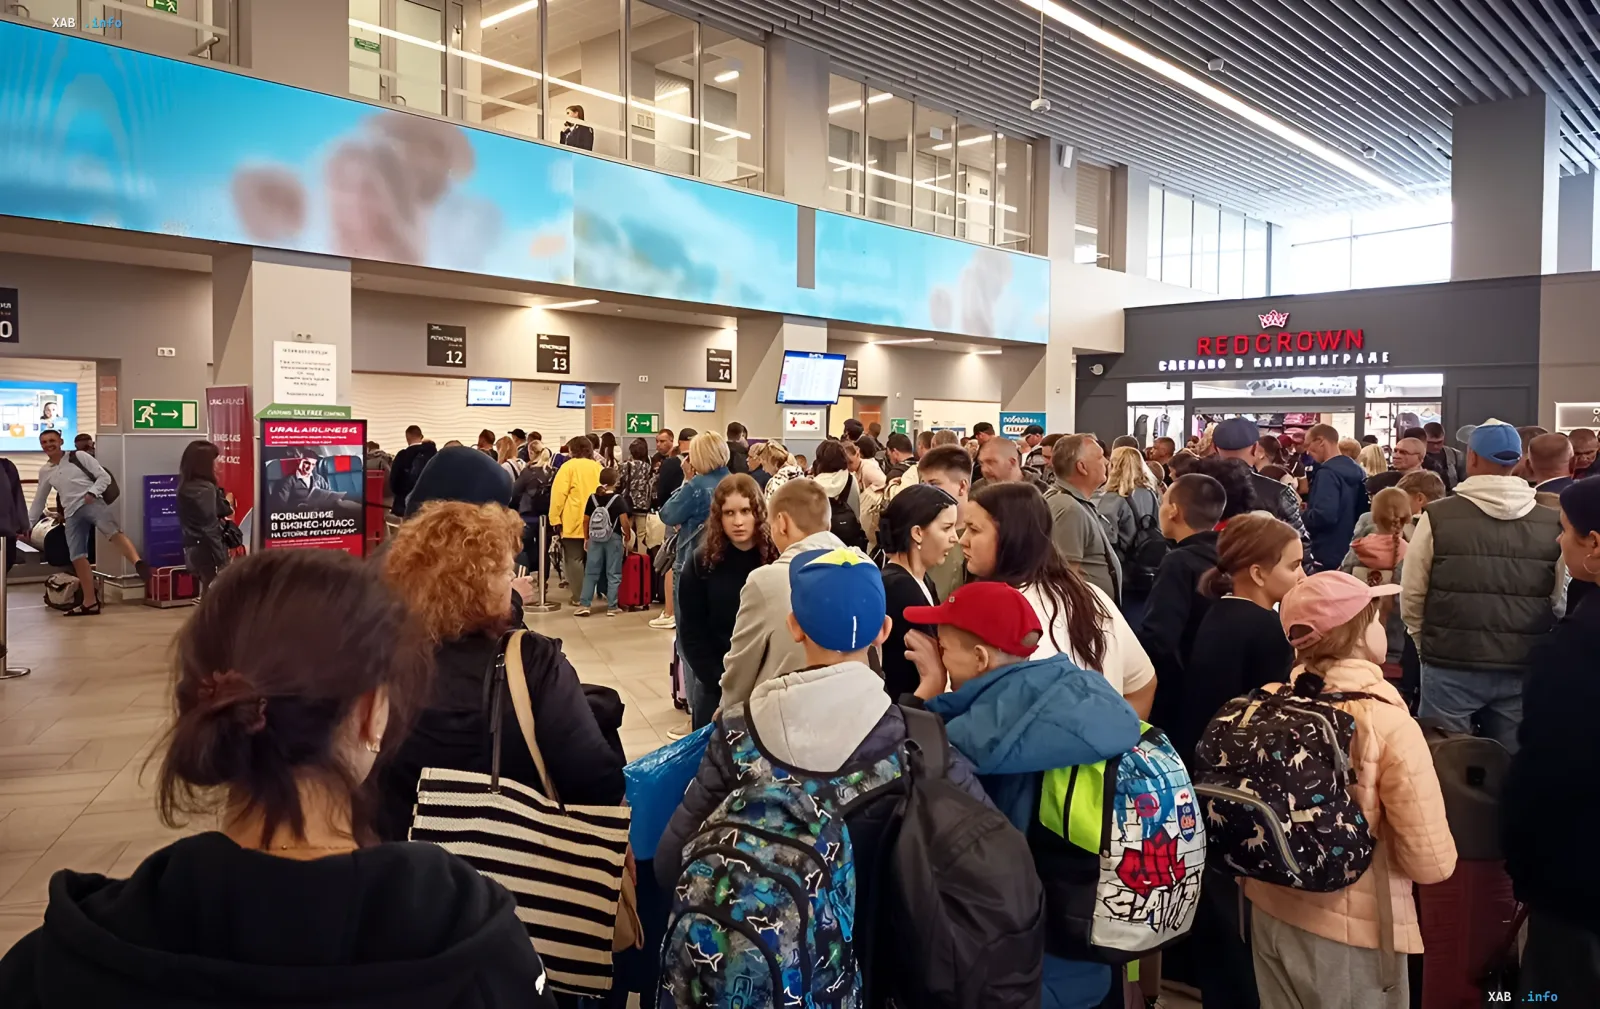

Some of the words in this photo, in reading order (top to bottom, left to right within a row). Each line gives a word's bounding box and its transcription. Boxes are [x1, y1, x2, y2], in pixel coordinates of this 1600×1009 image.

[446, 350, 463, 364] 12
[1235, 356, 1244, 369] В
[1253, 351, 1390, 368] КАЛИНИНГРАДЕ
[552, 357, 568, 371] 13
[719, 368, 730, 380] 14
[847, 377, 857, 388] 16
[306, 409, 323, 417] FREE
[271, 521, 278, 531] В
[271, 531, 281, 539] НА
